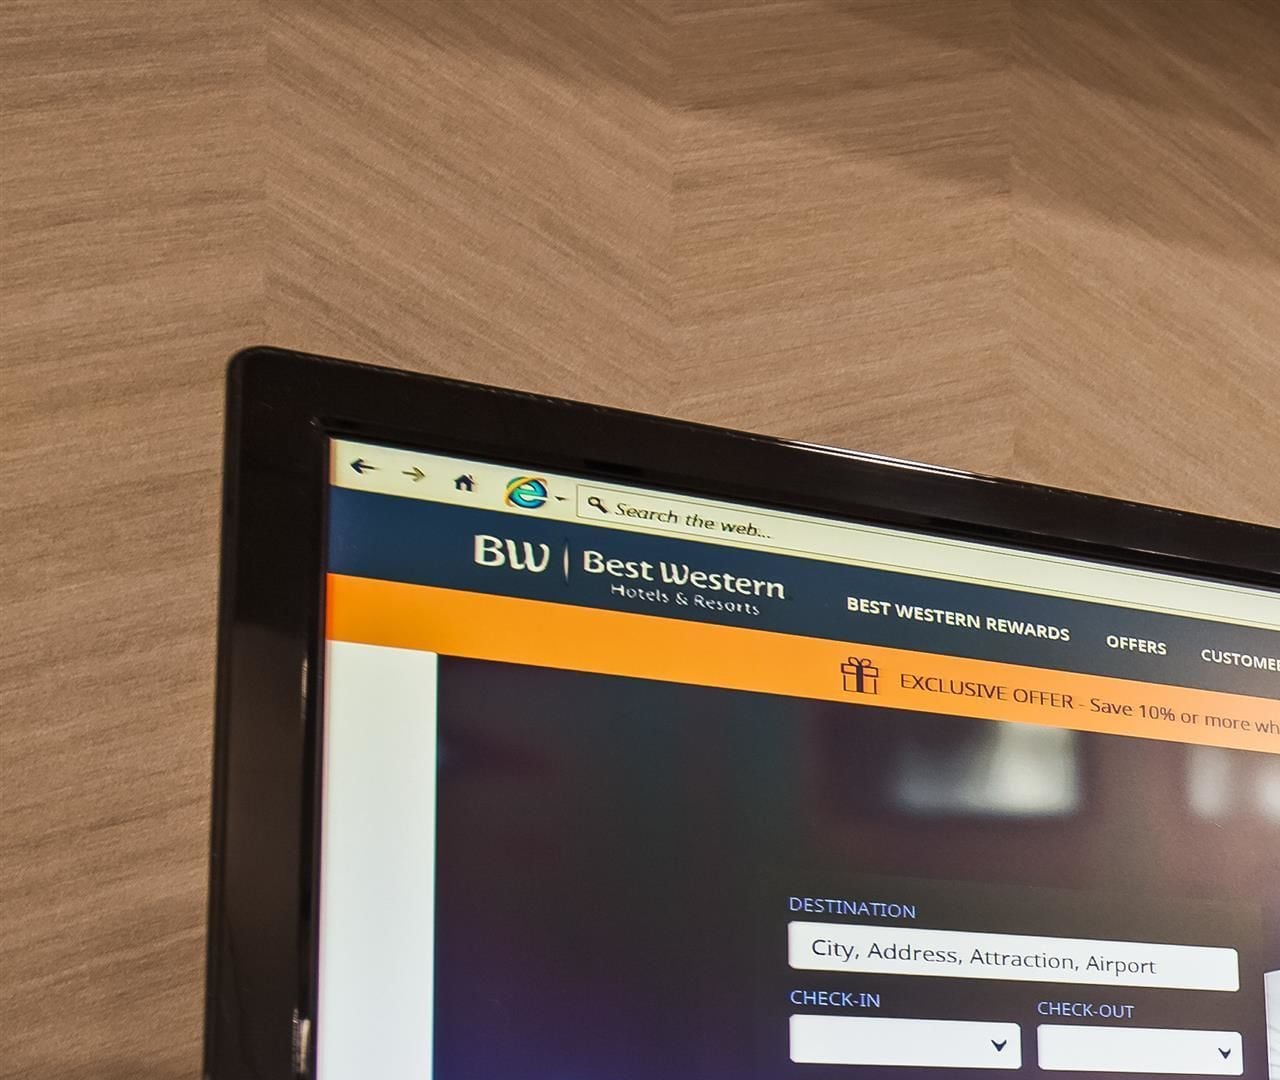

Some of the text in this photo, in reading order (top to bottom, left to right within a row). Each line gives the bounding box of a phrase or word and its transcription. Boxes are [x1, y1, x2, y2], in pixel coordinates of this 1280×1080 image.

[615, 502, 771, 540] Search the web...
[473, 533, 785, 599] BW Best Western
[610, 583, 760, 616] Hotels & Resorts
[846, 596, 1070, 642] BEST WESTERN REWARDS
[1106, 634, 1167, 655] OFFERS
[899, 673, 1008, 701] EXCLUSIVE
[1012, 688, 1074, 710] OFFER
[1089, 698, 1133, 718] Save
[1138, 704, 1176, 722] 10%
[1180, 711, 1199, 725] or
[1204, 714, 1251, 731] more
[788, 897, 916, 919] DESTINATION
[810, 939, 1158, 976] City, Address, Attraction, Airport
[790, 990, 881, 1008] CHECK-IN
[1037, 1001, 1135, 1019] CHECK-OUT
